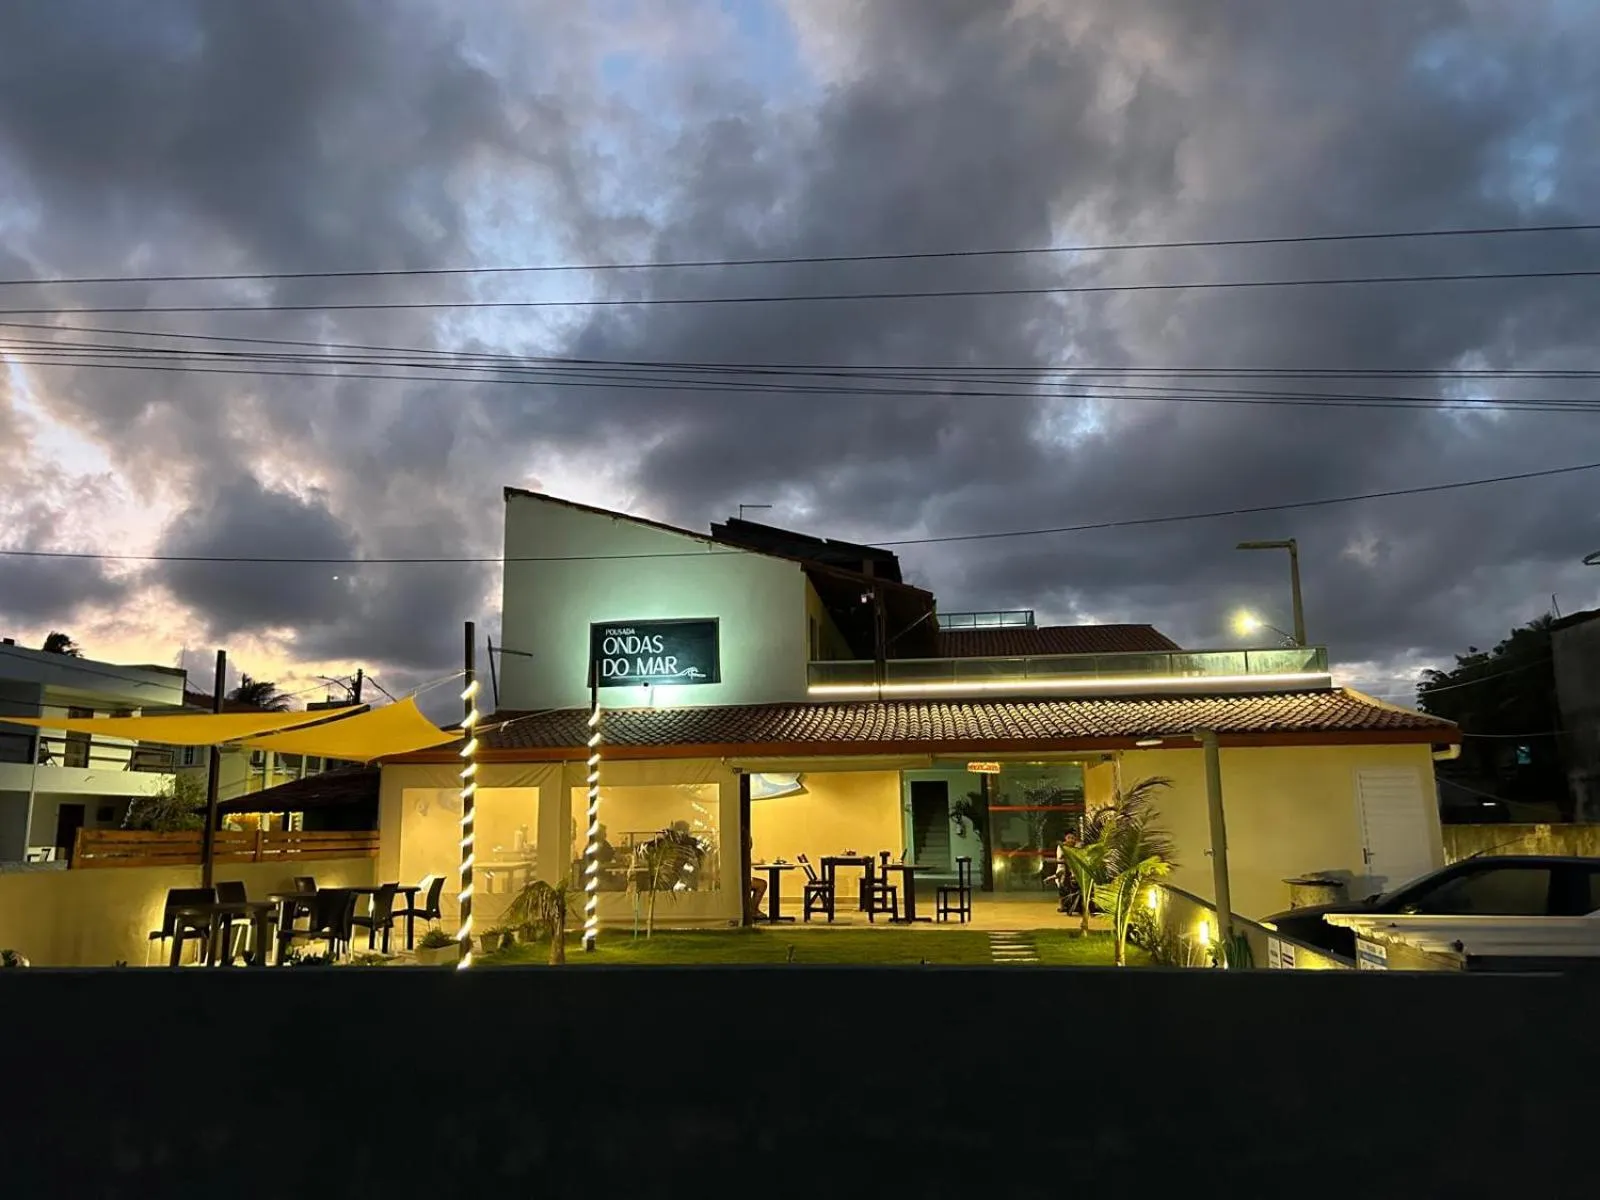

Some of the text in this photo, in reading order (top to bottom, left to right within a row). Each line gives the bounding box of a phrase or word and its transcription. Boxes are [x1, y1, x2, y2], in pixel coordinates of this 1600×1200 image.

[603, 635, 664, 655] ONDAS
[602, 656, 678, 677] DO MAR
